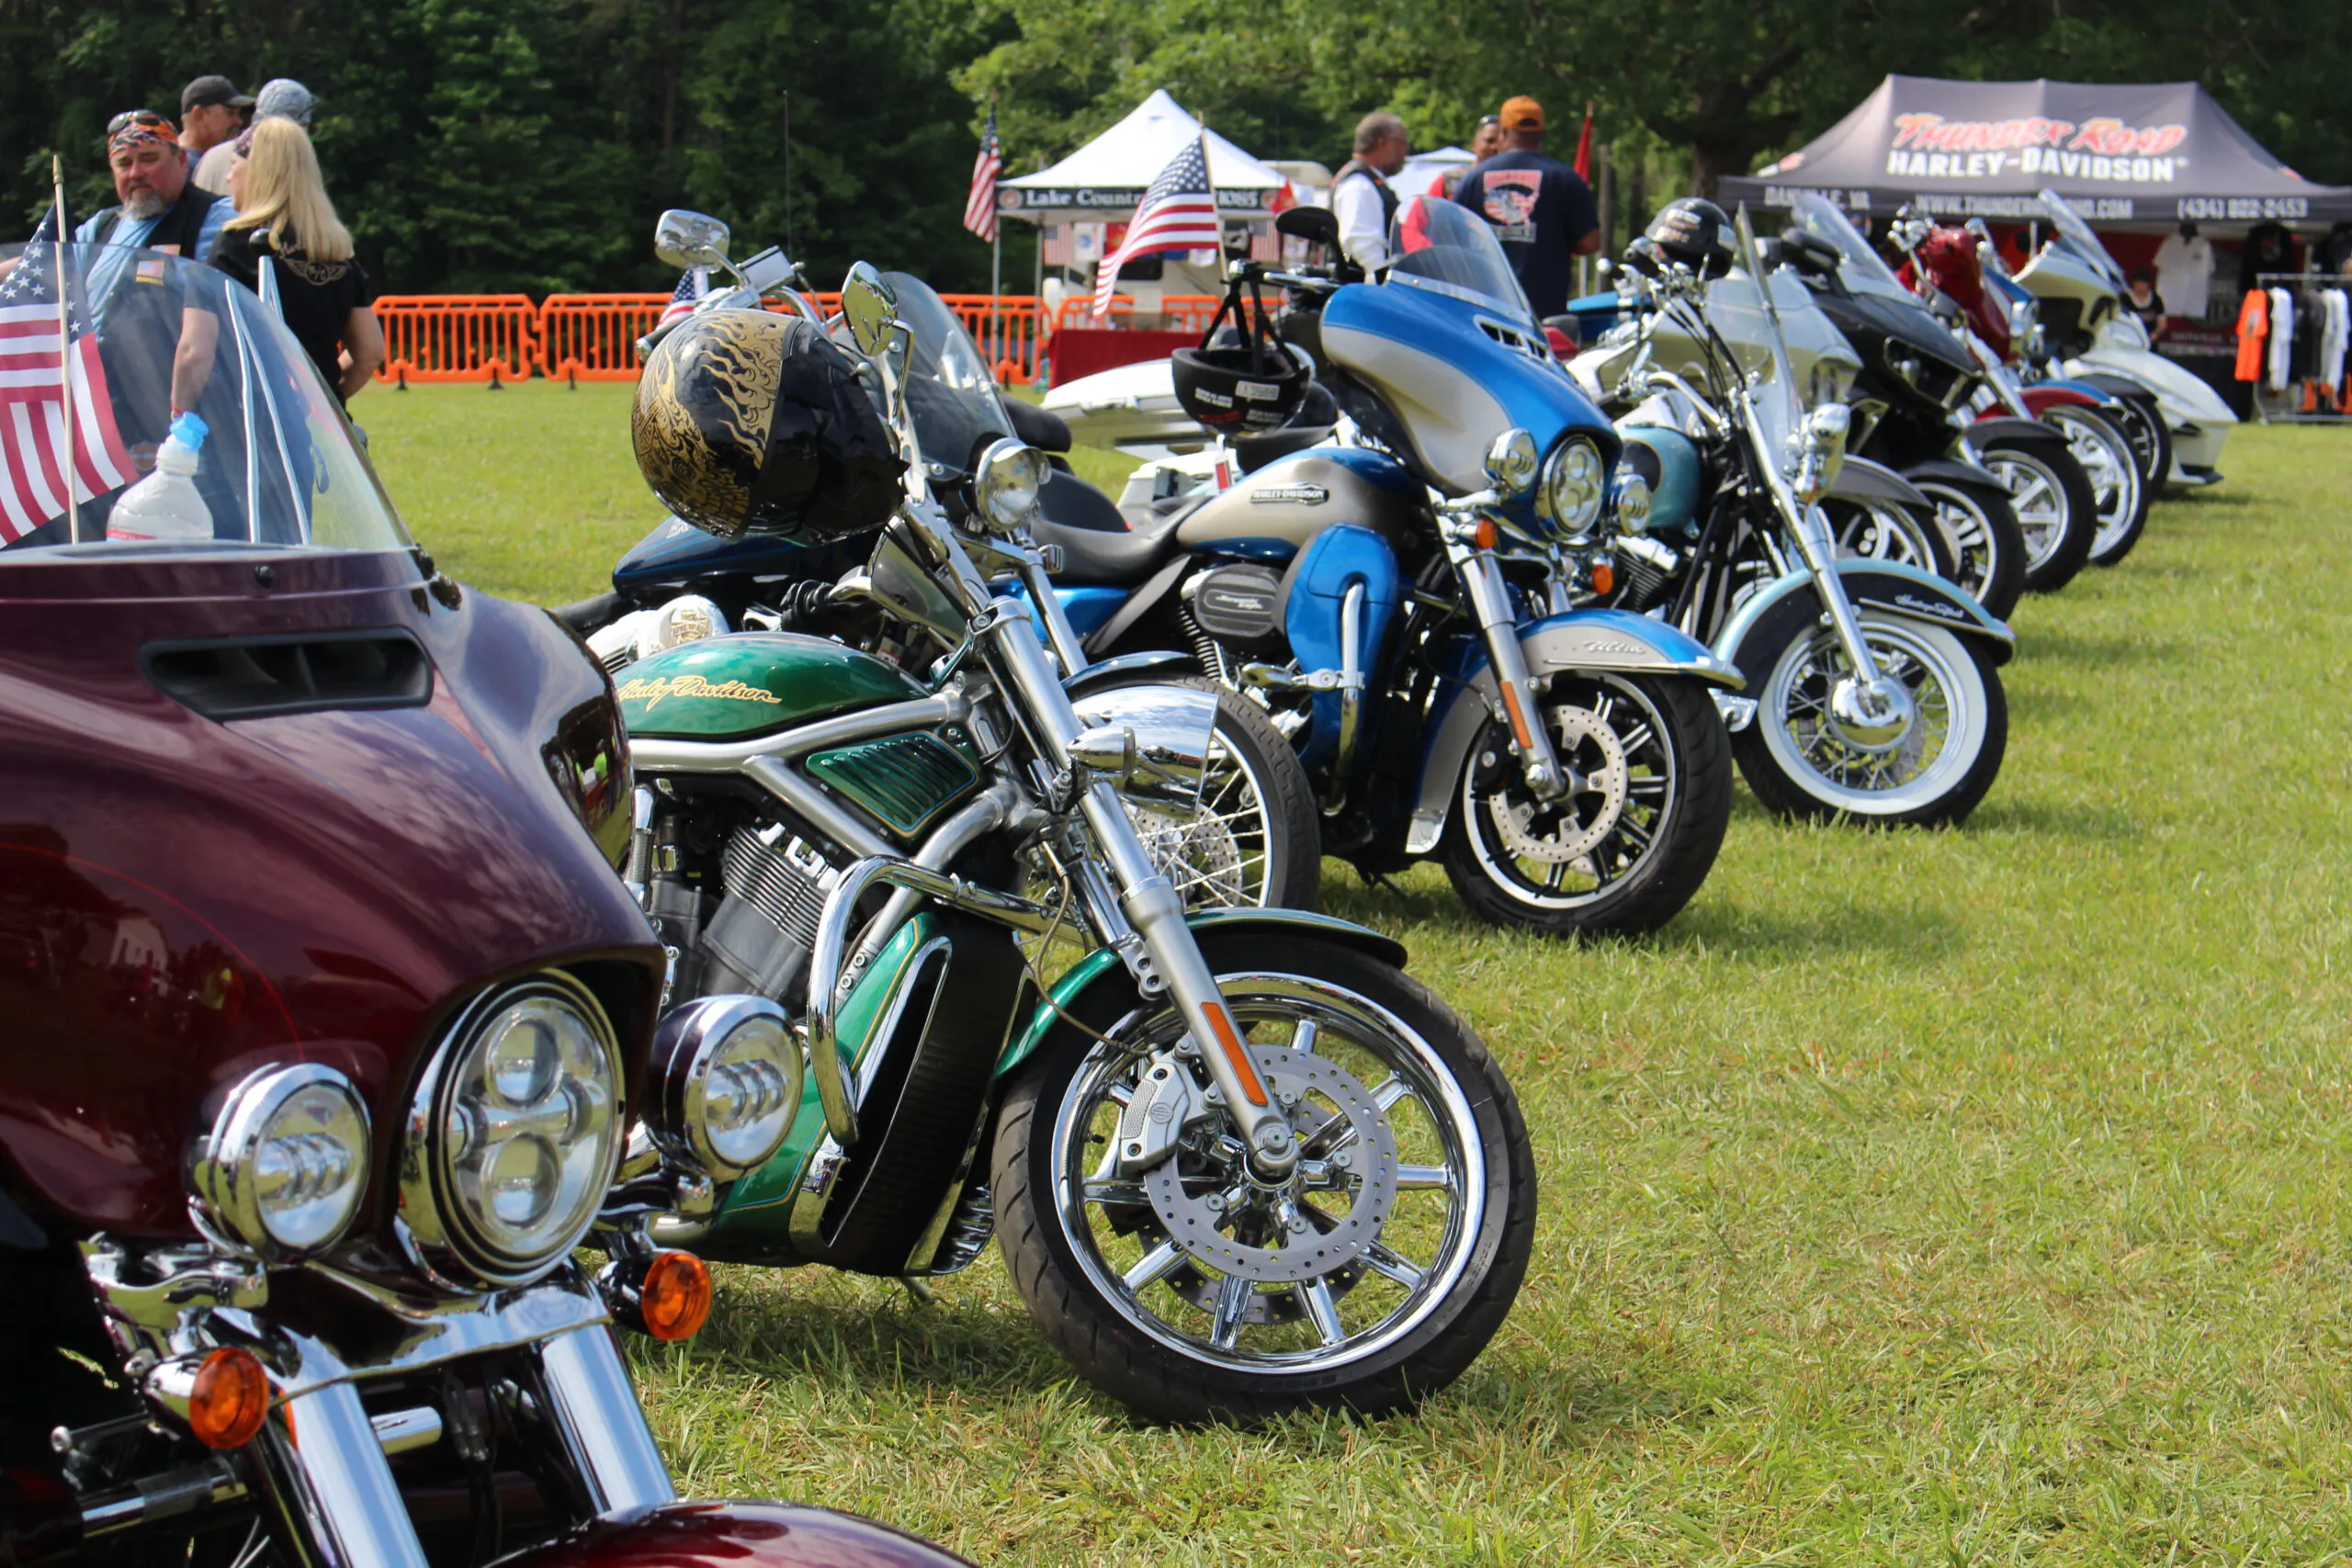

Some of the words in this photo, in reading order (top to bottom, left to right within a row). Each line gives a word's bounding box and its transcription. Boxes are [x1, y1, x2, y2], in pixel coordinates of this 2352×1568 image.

[1886, 146, 2177, 182] HARLEY-DAVIDSON
[1025, 189, 1071, 206] Lake
[1077, 189, 1143, 206] Countr
[1764, 186, 1846, 209] DANLE,
